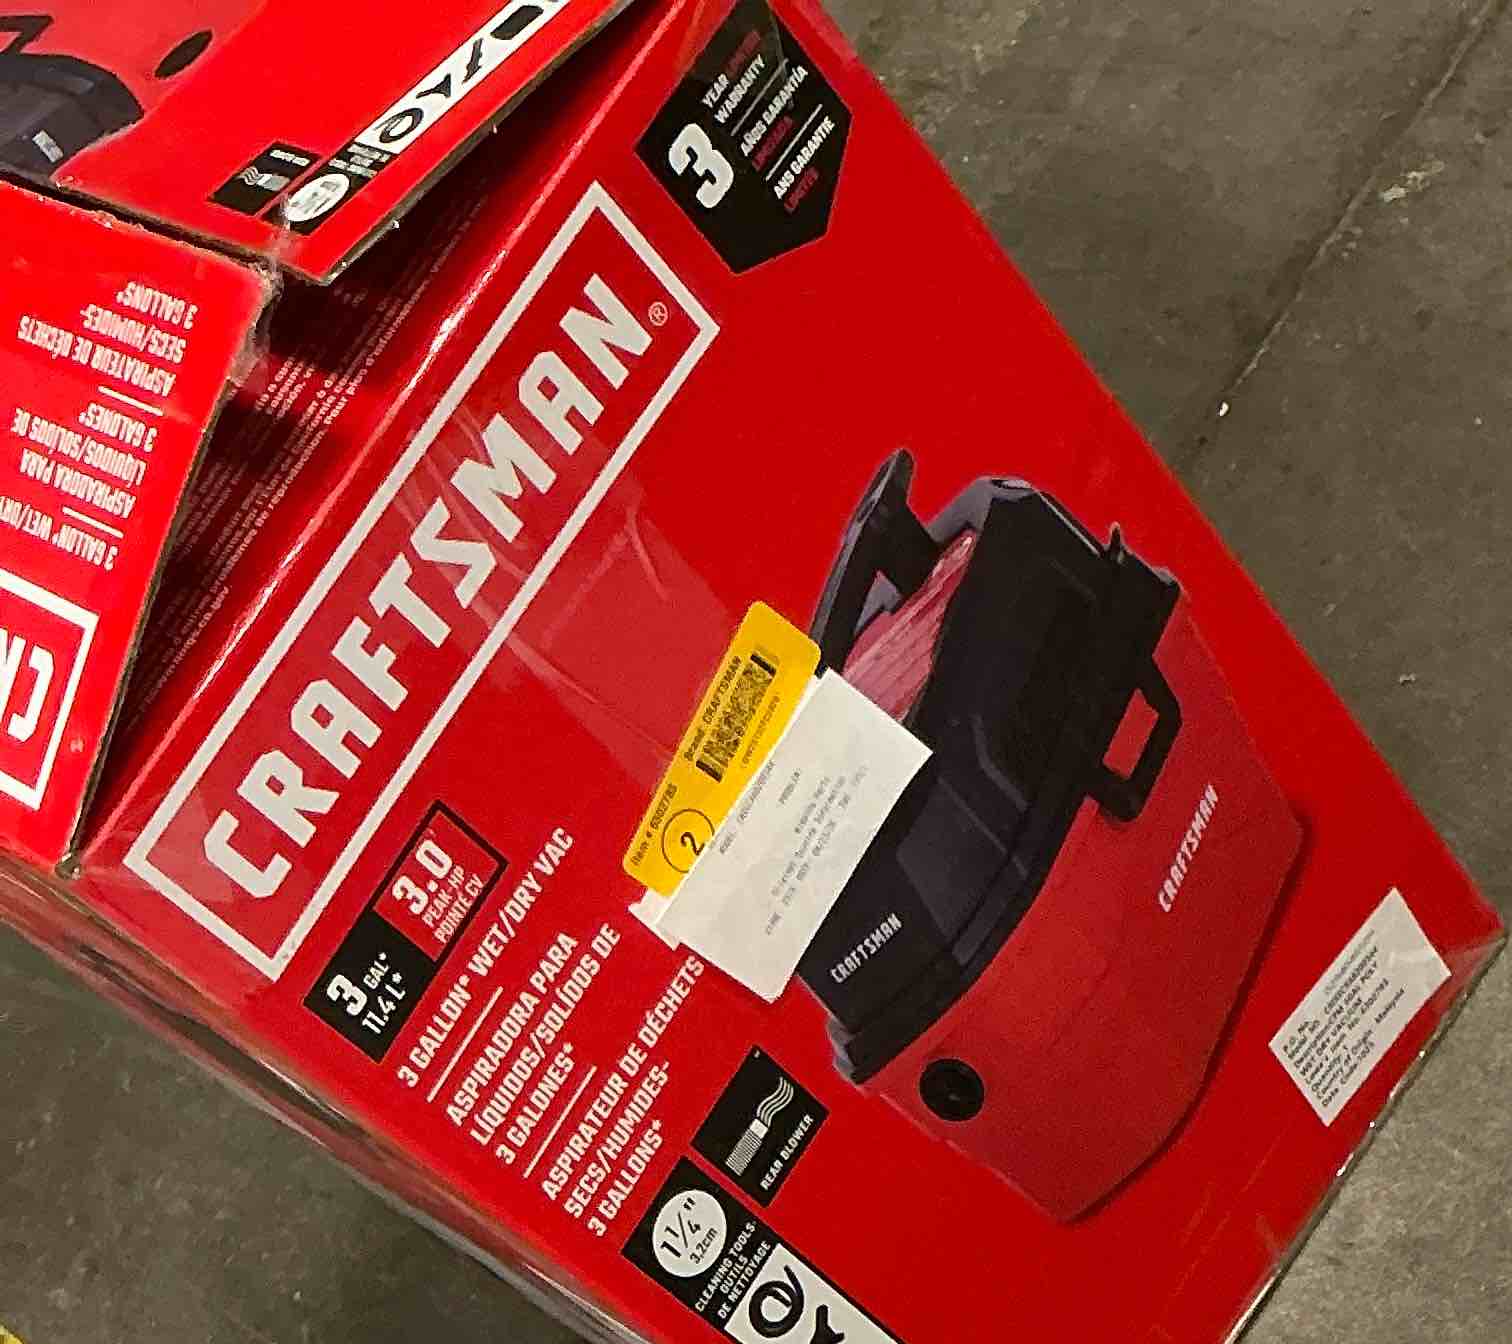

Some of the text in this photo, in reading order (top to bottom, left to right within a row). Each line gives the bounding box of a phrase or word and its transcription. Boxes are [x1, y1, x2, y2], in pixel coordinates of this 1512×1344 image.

[701, 73, 729, 108] YEAR
[713, 53, 765, 123] WARRANTY
[669, 123, 734, 208] 3
[773, 169, 795, 199] ANS
[789, 115, 835, 174] GARANTIE
[680, 831, 705, 856] 2
[1158, 784, 1218, 912] CRAFTSMAN
[397, 1065, 419, 1087] 3
[467, 871, 542, 976] WET/DRY
[533, 827, 573, 874] VAC
[830, 913, 902, 982] CRAFTSMAN
[326, 974, 367, 1015] 3
[446, 933, 578, 1126] ASPIRADORA PARA
[541, 955, 704, 1200] ASPIRATEUR DE DÉCHETS
[495, 1143, 515, 1164] 3
[759, 1113, 813, 1190] REAR BLOWER
[587, 1216, 606, 1236] 3
[719, 1254, 748, 1293] OUTILS
